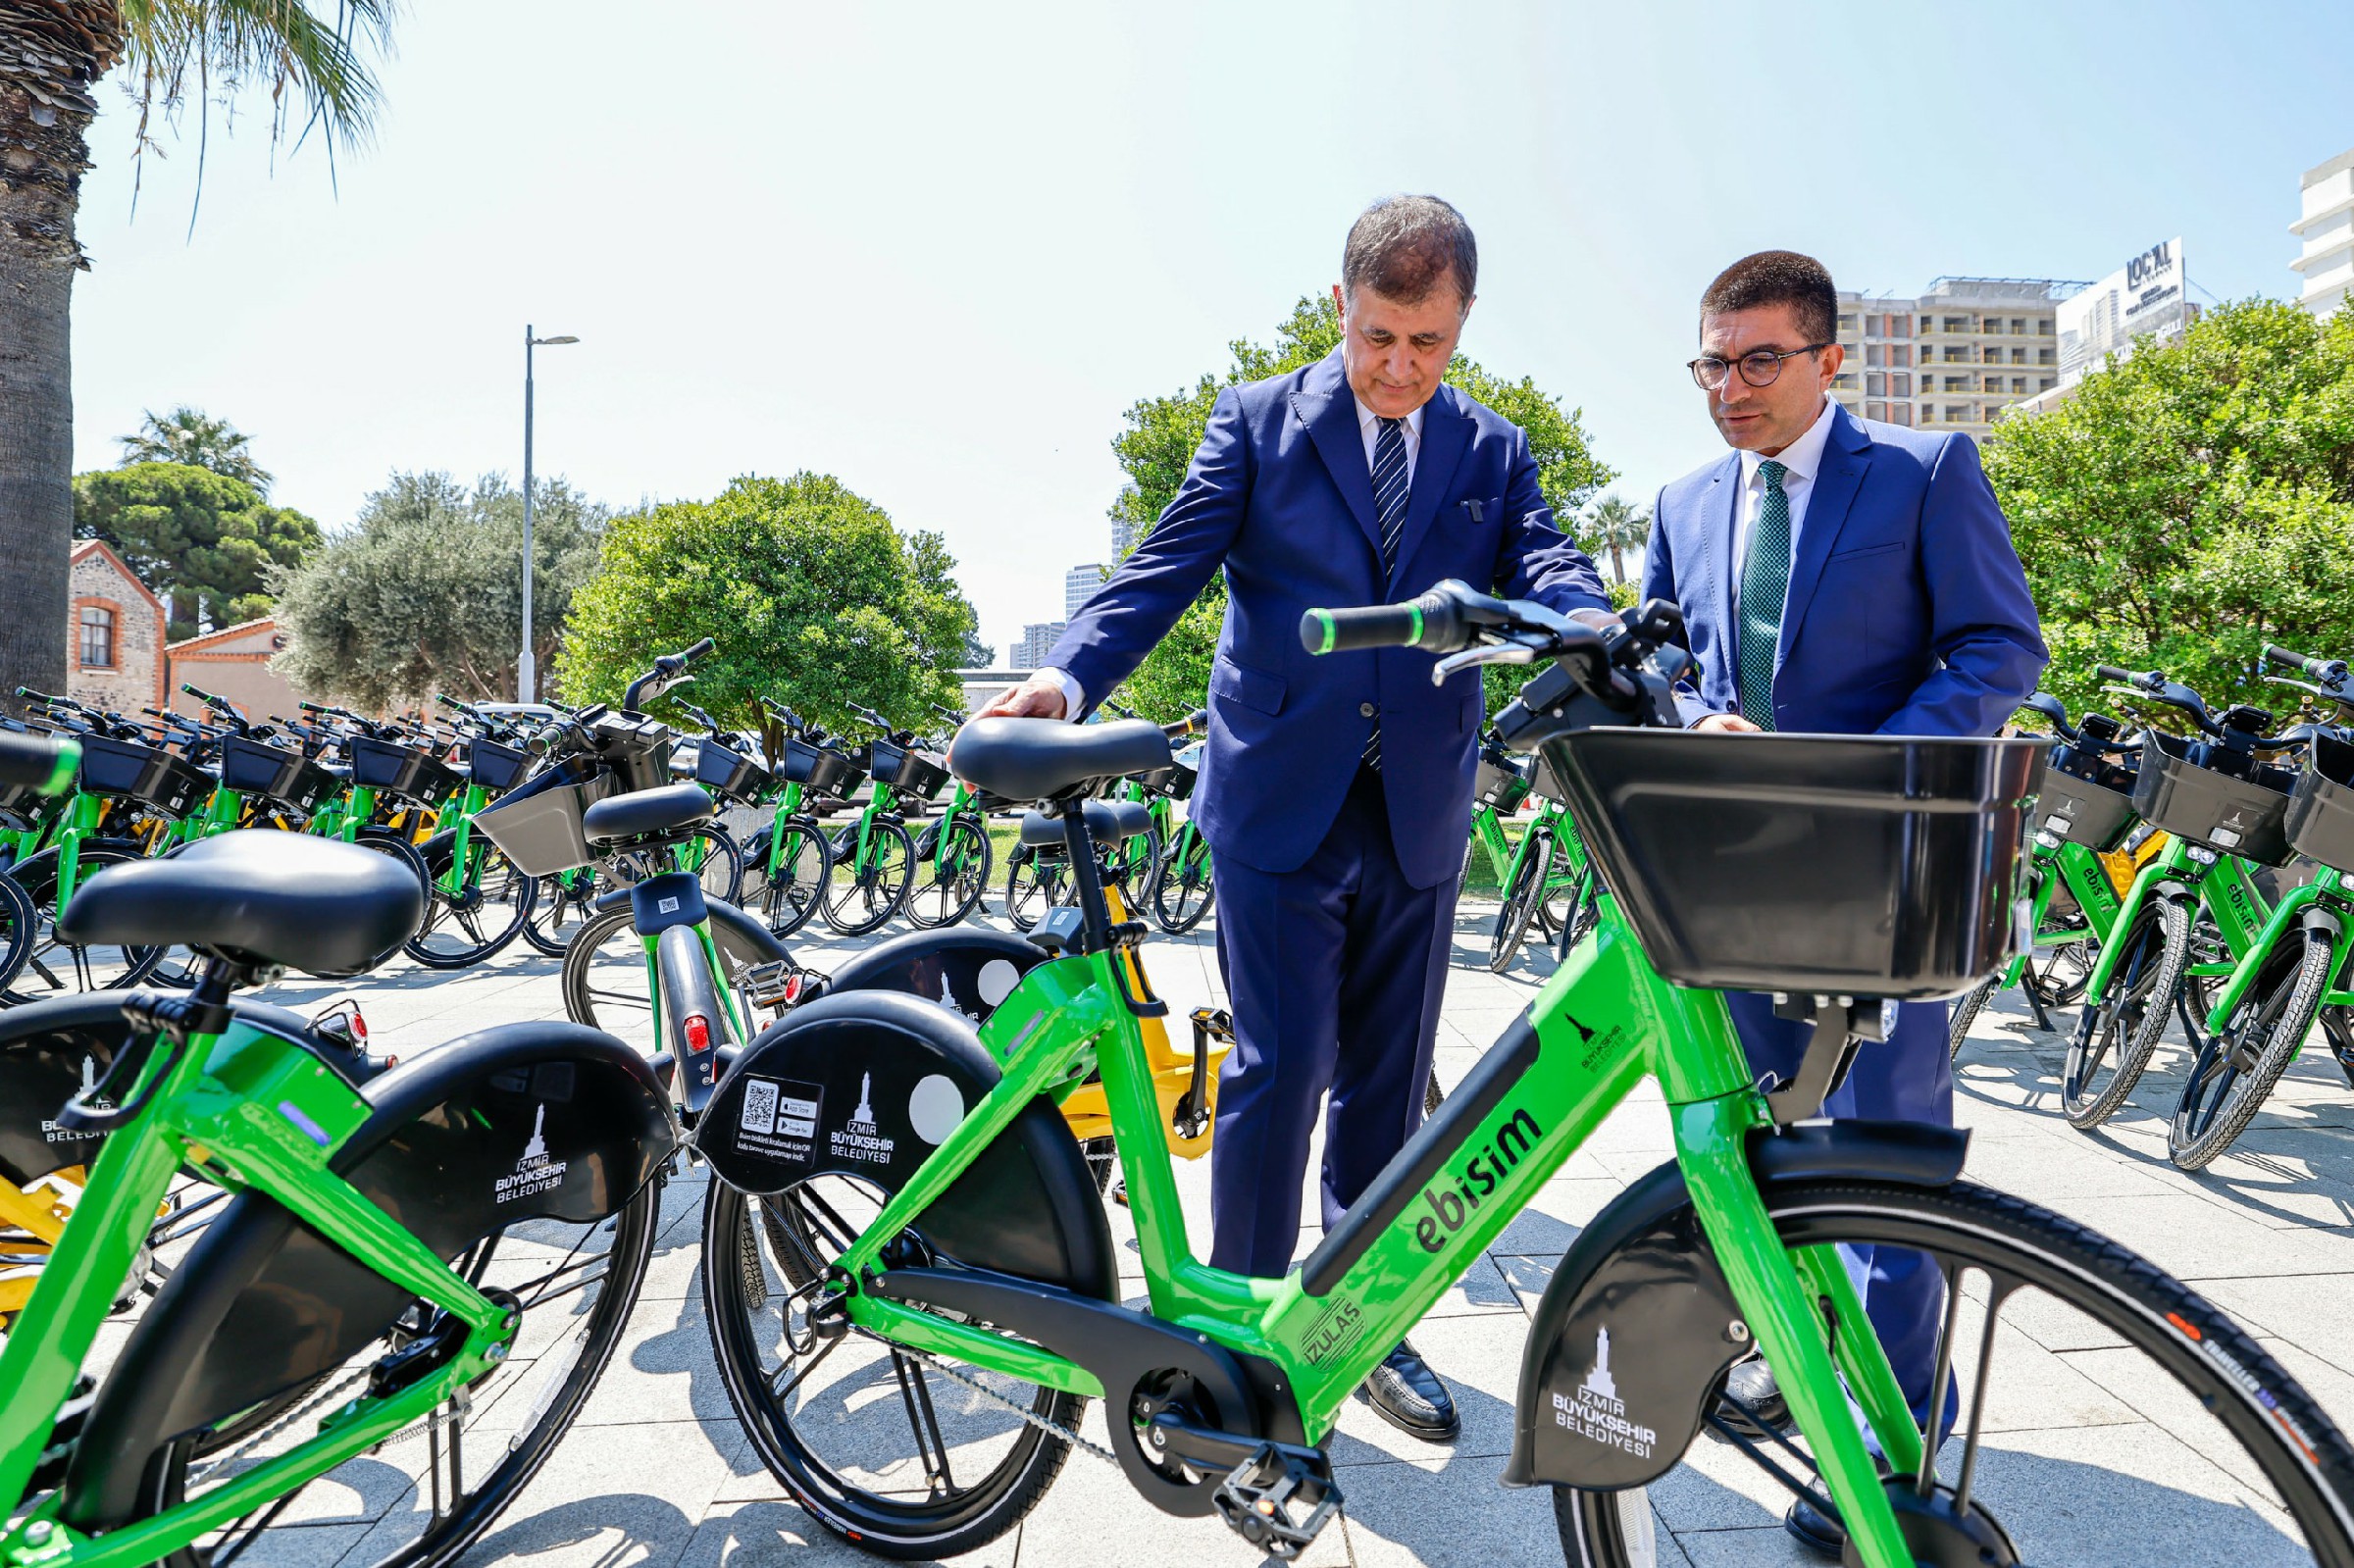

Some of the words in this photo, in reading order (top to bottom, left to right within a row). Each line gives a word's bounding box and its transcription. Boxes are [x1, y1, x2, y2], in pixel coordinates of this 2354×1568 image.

[2083, 867, 2114, 914] ebisim
[2227, 884, 2257, 933] ebisim
[1416, 1108, 1543, 1254] ebisim
